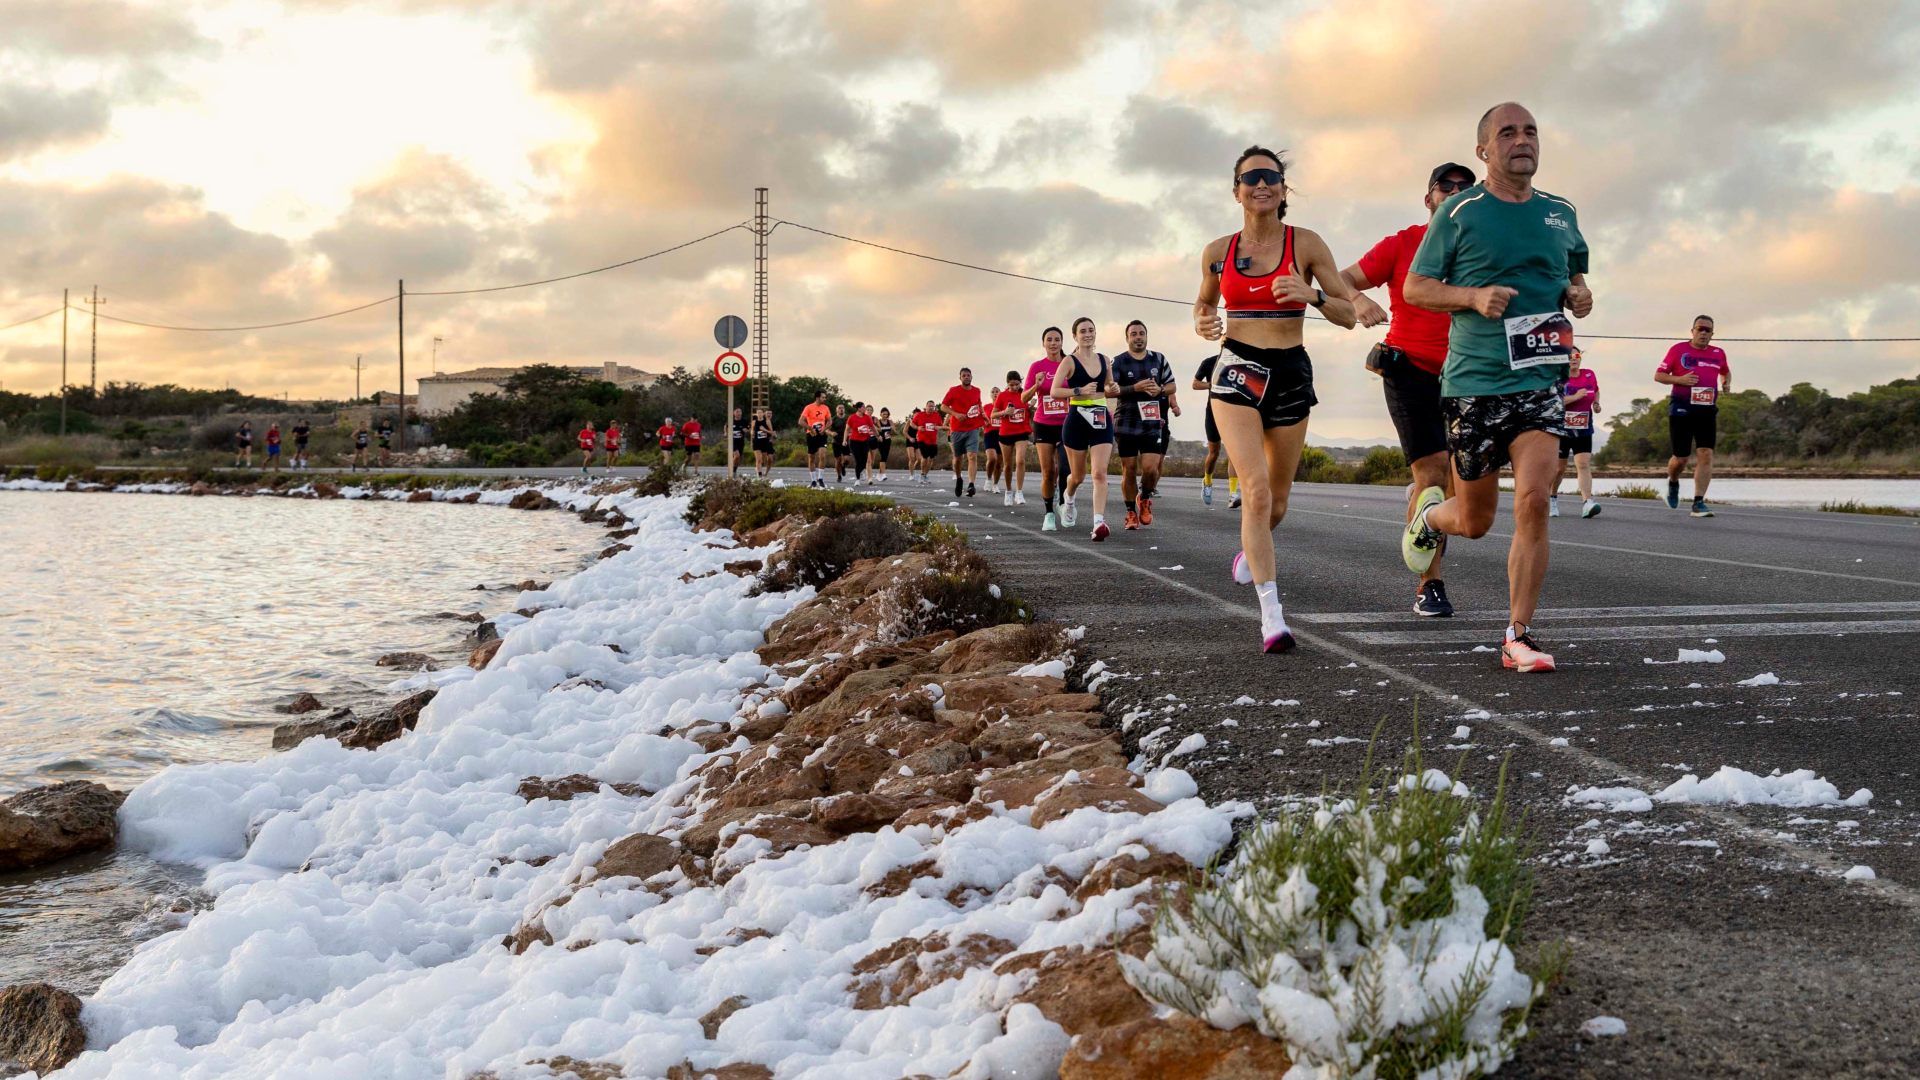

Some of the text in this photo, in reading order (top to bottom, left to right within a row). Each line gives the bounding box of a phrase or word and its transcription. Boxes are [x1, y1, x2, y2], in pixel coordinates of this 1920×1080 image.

[1544, 217, 1569, 228] BERLIN
[1526, 331, 1561, 348] 812
[722, 362, 741, 375] 60
[1227, 369, 1246, 385] 98
